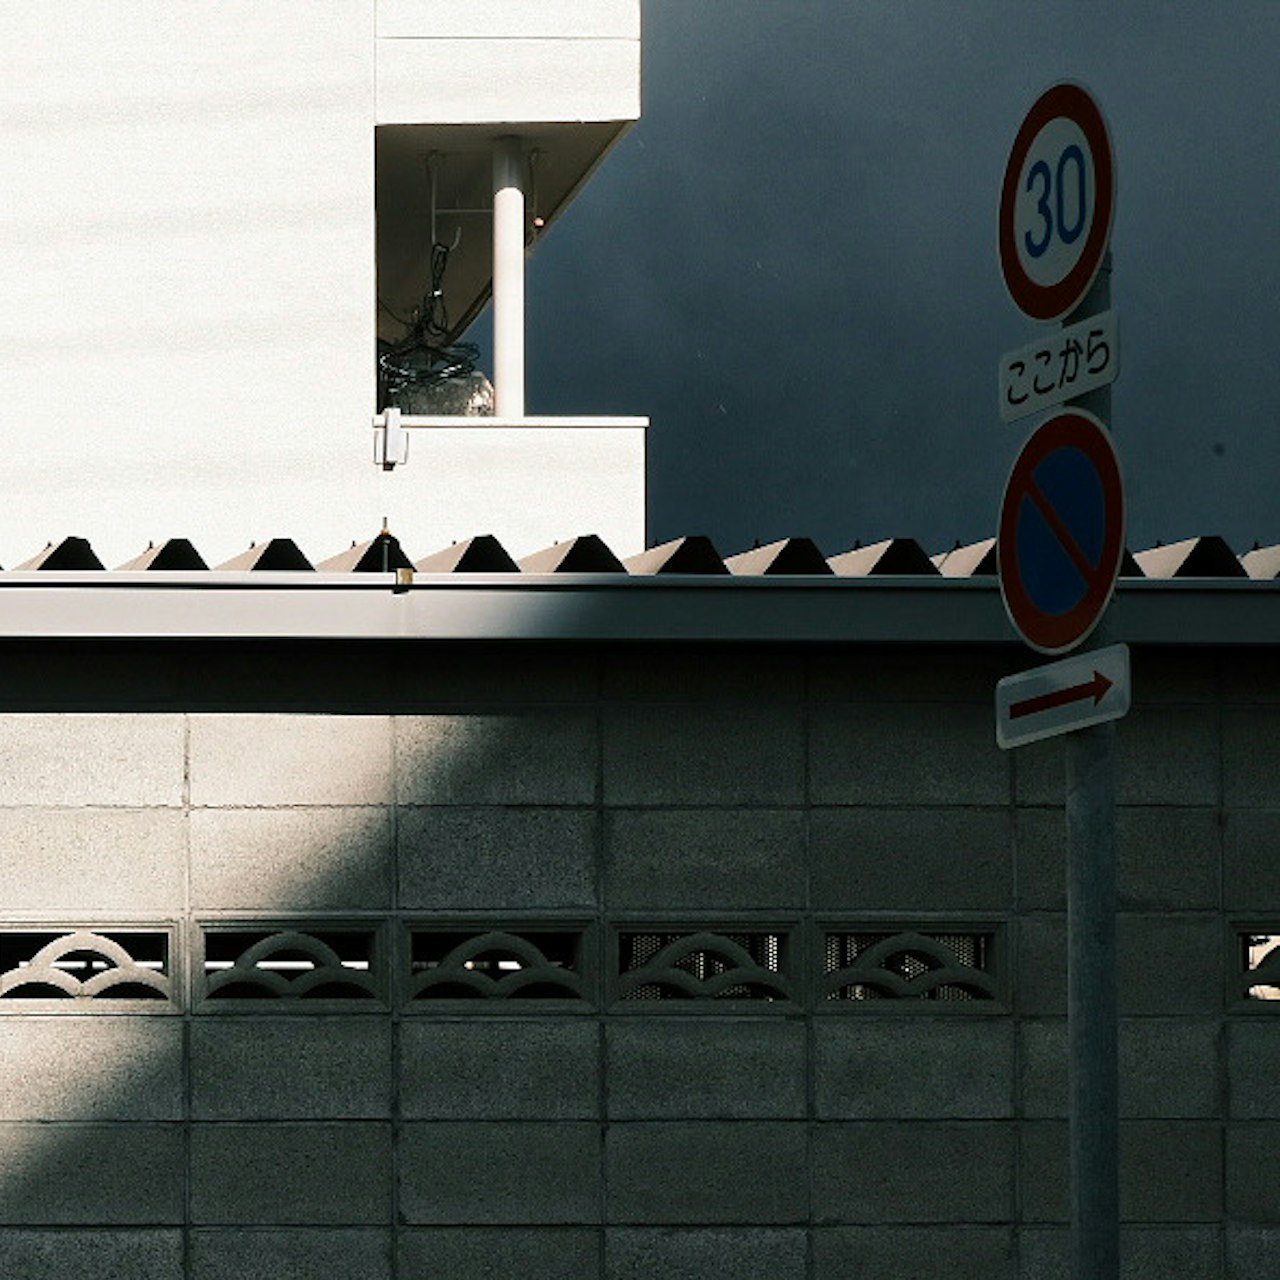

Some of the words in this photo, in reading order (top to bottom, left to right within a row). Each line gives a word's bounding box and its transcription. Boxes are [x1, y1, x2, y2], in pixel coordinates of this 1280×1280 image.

[1025, 145, 1086, 258] 30
[1007, 330, 1110, 405] ここから
